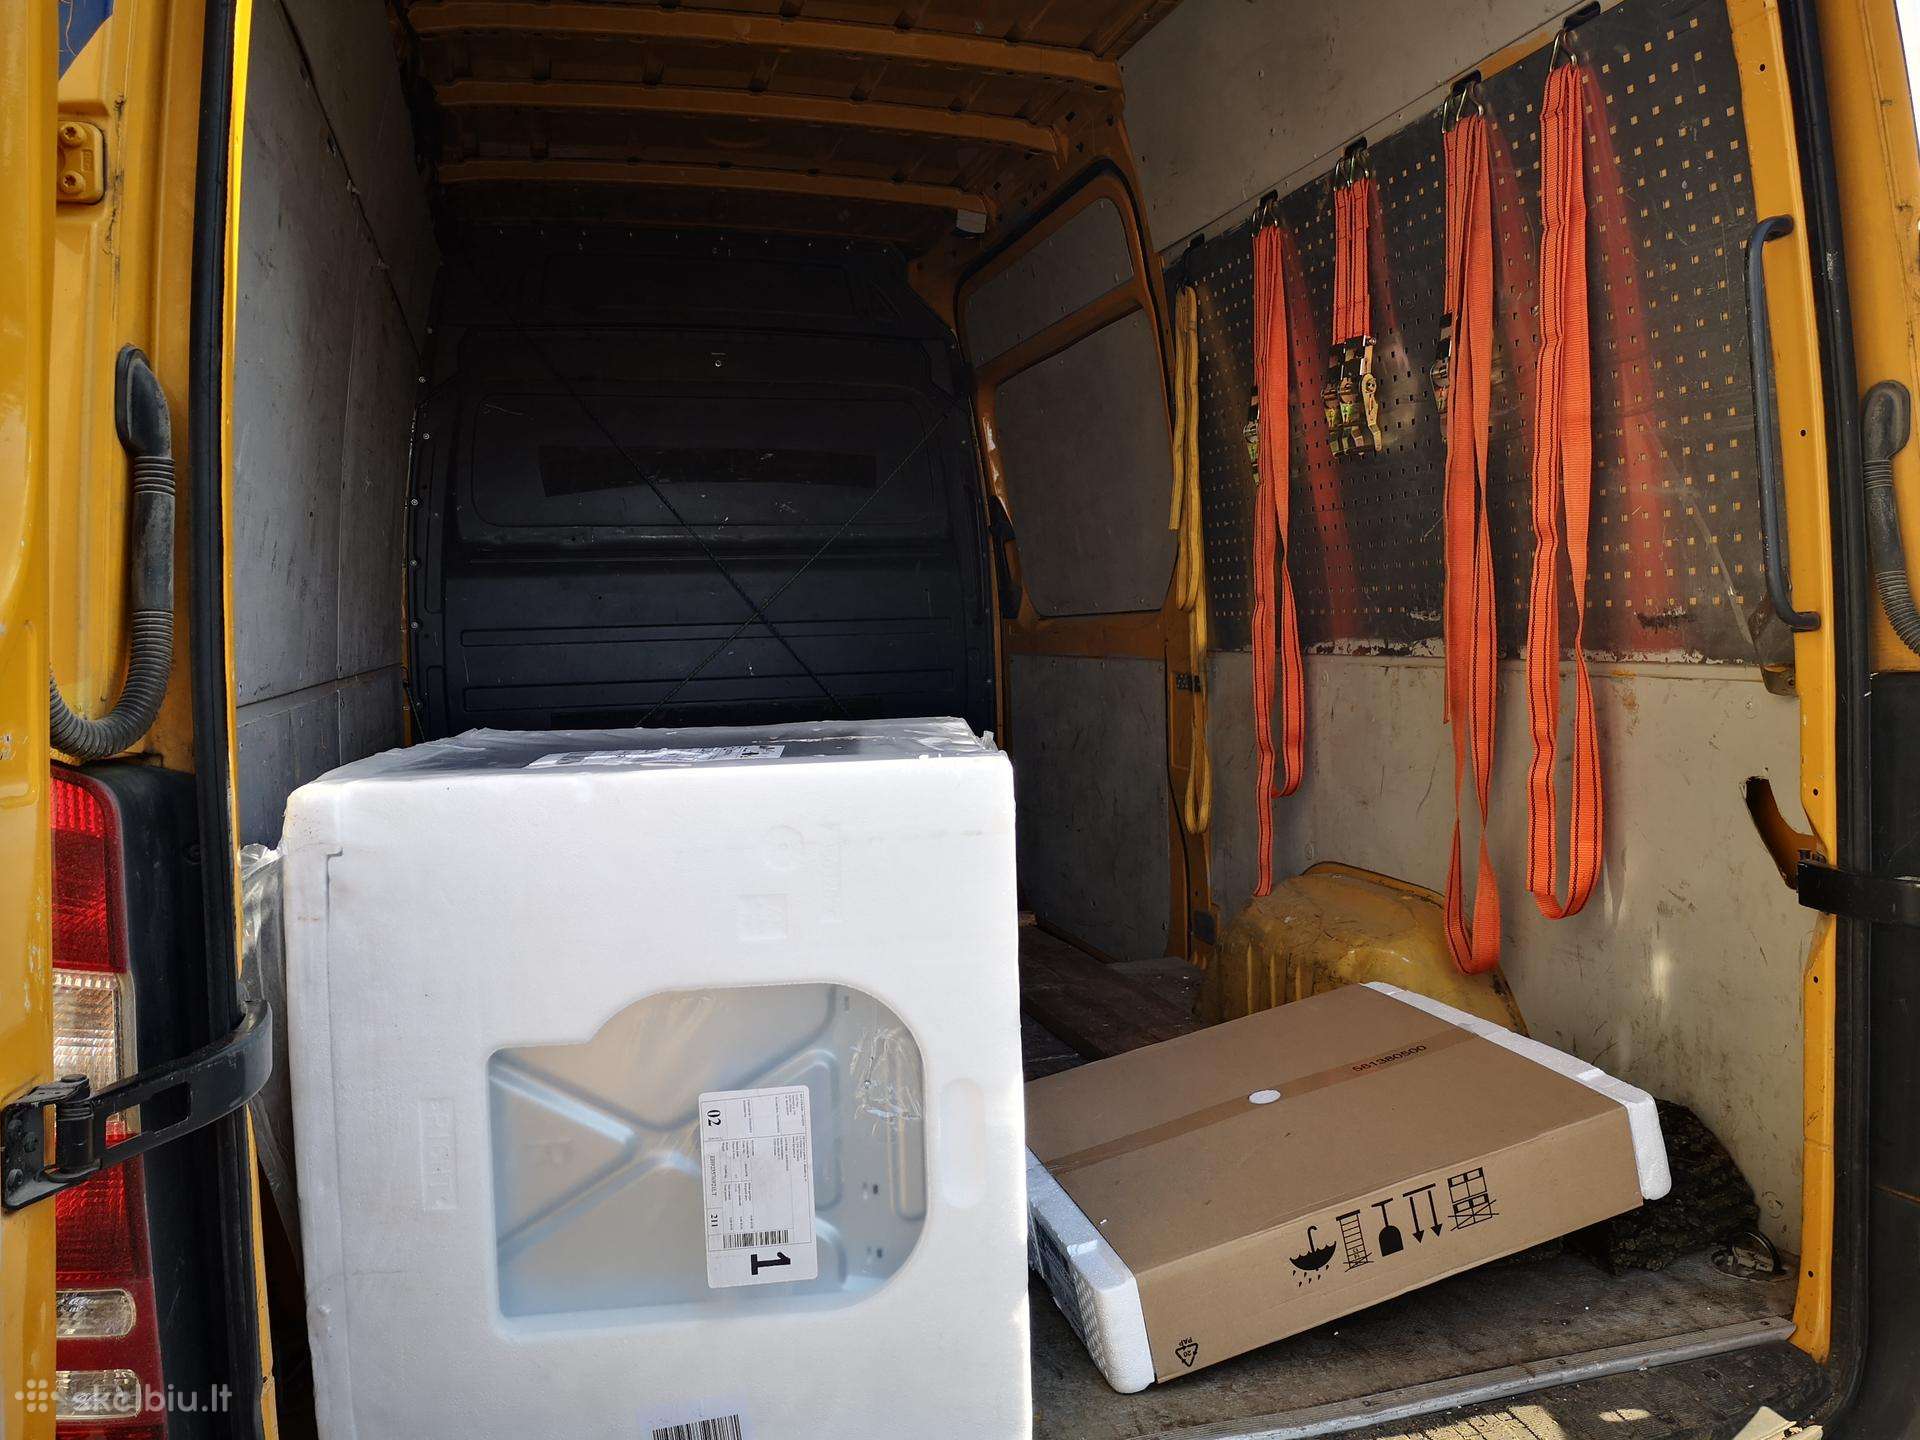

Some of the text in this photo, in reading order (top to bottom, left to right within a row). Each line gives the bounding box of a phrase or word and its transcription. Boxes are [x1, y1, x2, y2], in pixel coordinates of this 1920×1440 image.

[707, 1110, 721, 1126] 02
[710, 1214, 718, 1227] 211
[751, 1252, 791, 1275] 1
[1179, 1336, 1193, 1347] PAP
